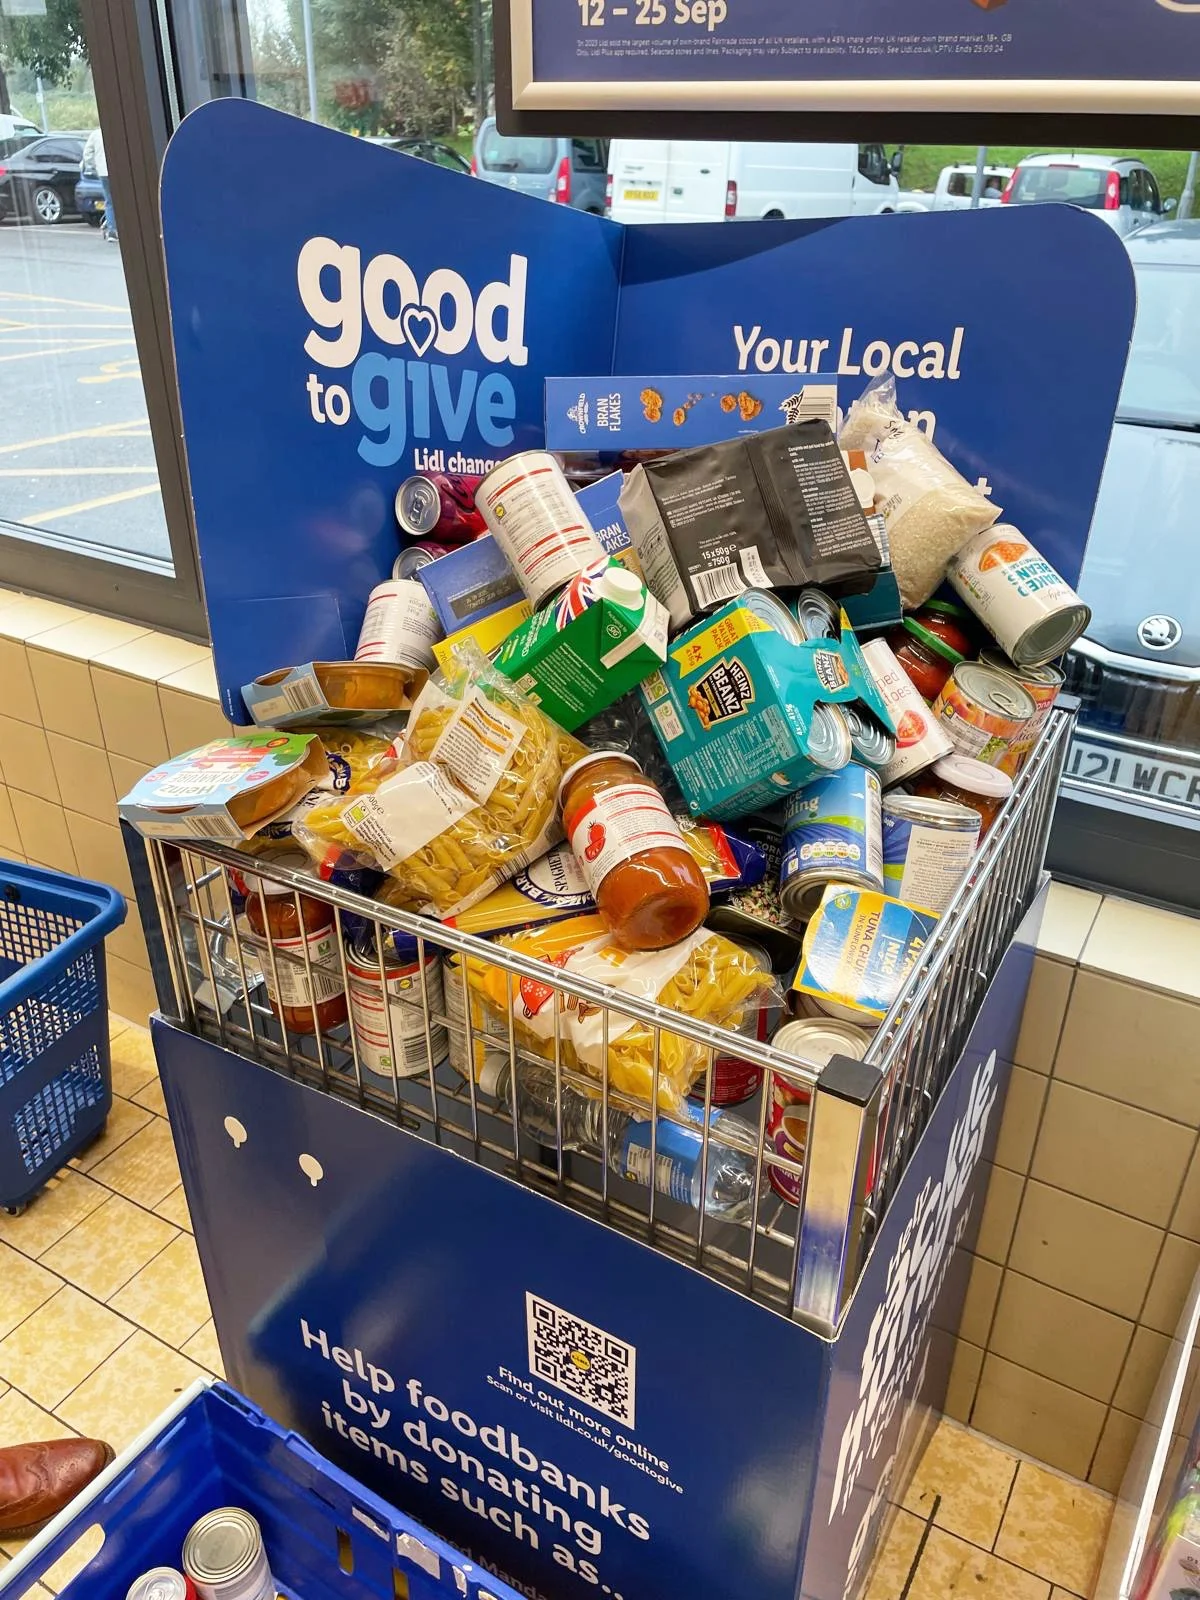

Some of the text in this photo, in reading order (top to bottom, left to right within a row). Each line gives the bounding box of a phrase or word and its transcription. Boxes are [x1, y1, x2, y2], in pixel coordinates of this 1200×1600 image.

[578, 0, 605, 26] 12
[636, 0, 667, 25] 25
[674, 0, 728, 32] Sep
[297, 236, 529, 369] good
[733, 325, 965, 381] Your Local
[306, 351, 517, 467] to give
[596, 398, 609, 428] BRAN
[609, 392, 621, 432] FLAKES
[414, 447, 445, 473] Lidl
[605, 530, 631, 553] AKES
[710, 629, 723, 650] PACK
[716, 622, 731, 648] VALUE
[723, 617, 739, 642] GREAT
[712, 666, 741, 714] BEANZ
[729, 664, 751, 700] HEINZ
[820, 652, 837, 688] BEANZ
[159, 784, 216, 798] Heinz
[859, 914, 866, 923] IN
[861, 911, 881, 941] TUNA
[858, 1048, 997, 1399] tackle
[886, 1176, 932, 1292] Help
[829, 1082, 998, 1525] hunger
[299, 1317, 396, 1394] Help
[405, 1378, 650, 1541] foodbanks
[486, 1374, 684, 1494] Scan or visit lidl.co.uk/goodtogive
[498, 1366, 669, 1472] Find out more online
[320, 1400, 429, 1485] items
[440, 1475, 539, 1550] such
[343, 1378, 391, 1429] by
[402, 1420, 602, 1556] donating
